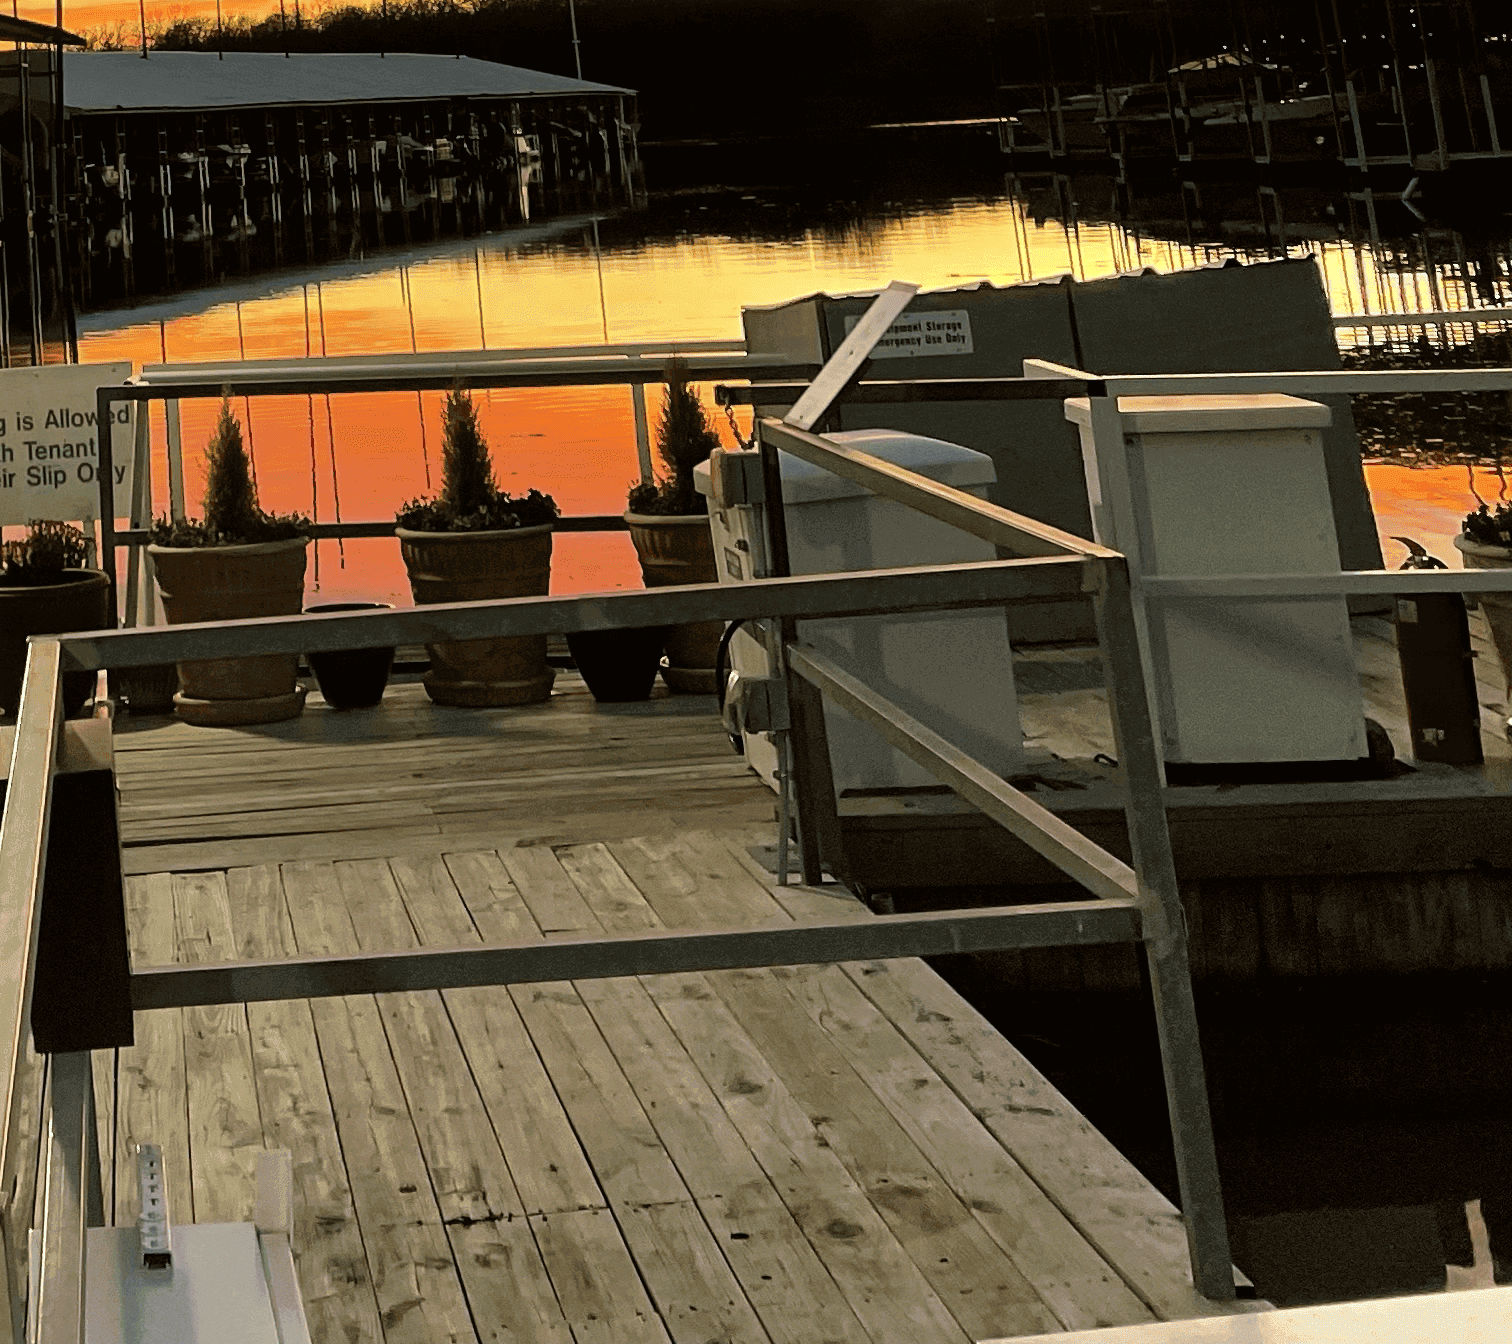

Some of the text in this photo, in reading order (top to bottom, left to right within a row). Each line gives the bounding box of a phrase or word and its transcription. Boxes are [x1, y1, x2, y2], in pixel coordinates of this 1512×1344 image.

[926, 321, 962, 332] Storage
[925, 334, 942, 344] Use
[946, 332, 966, 344] Only
[16, 412, 34, 432] is
[23, 438, 96, 461] Tenant
[26, 465, 67, 489] Slip
[77, 462, 126, 485] Oy
